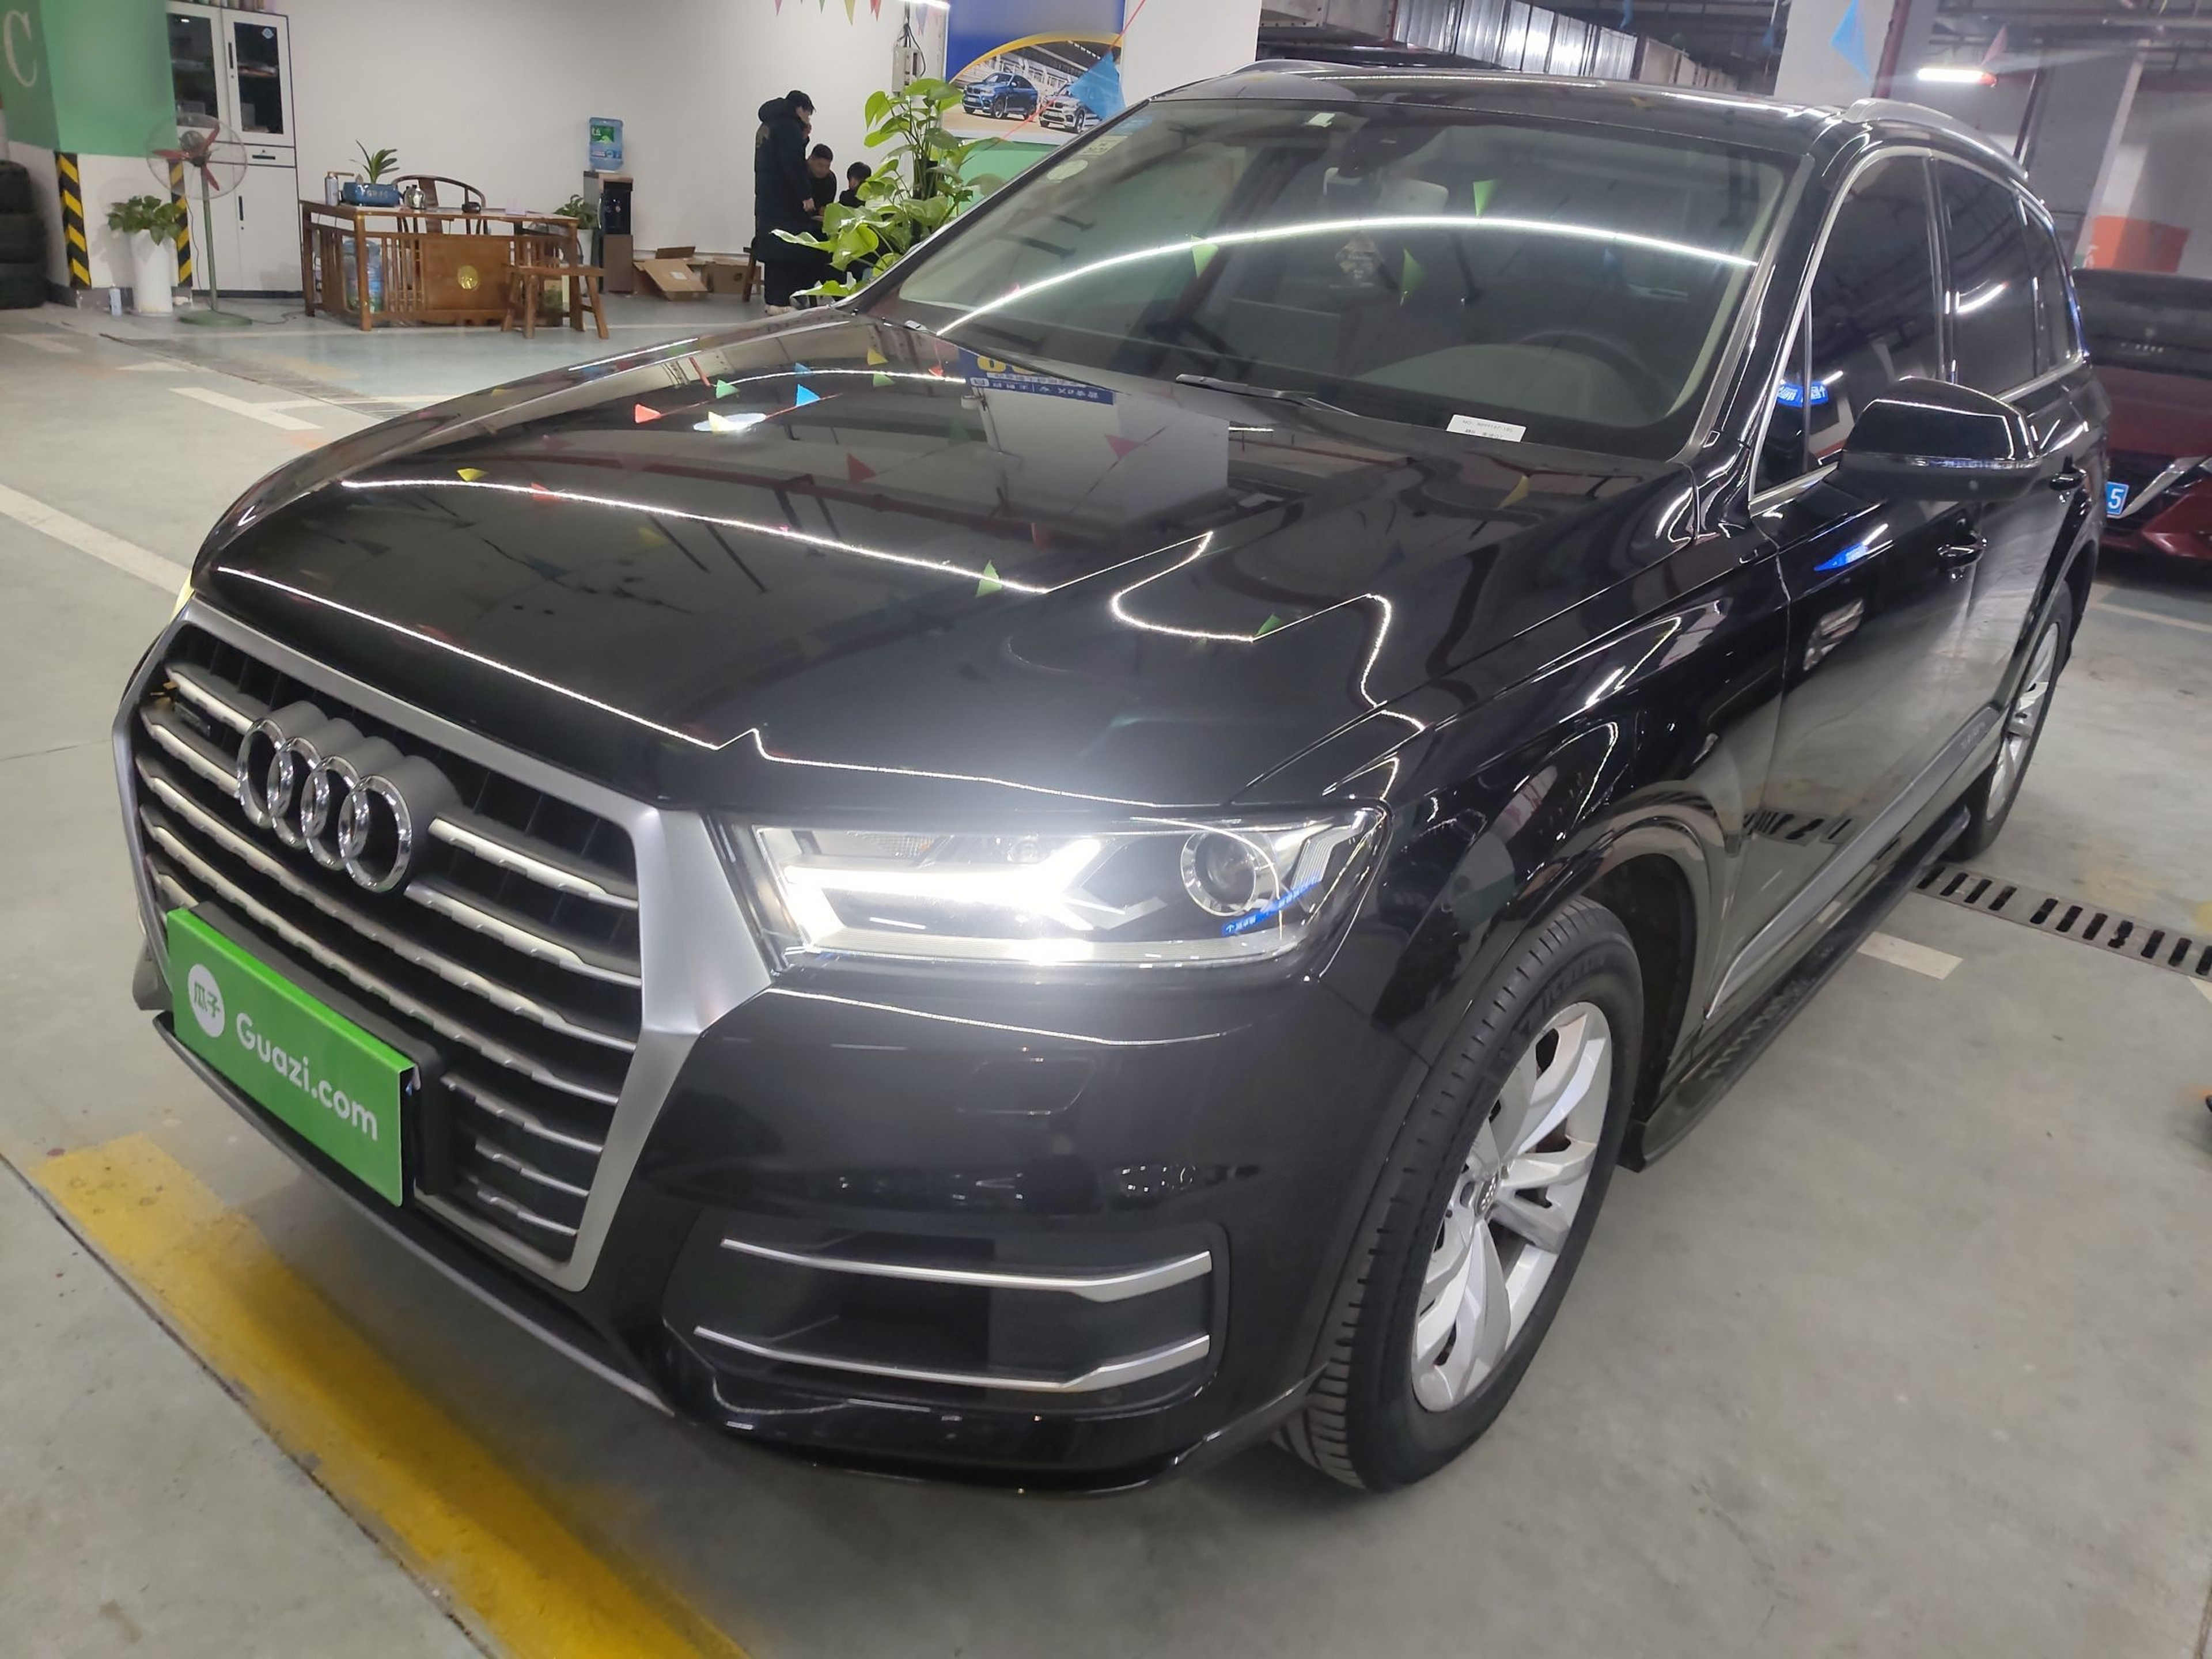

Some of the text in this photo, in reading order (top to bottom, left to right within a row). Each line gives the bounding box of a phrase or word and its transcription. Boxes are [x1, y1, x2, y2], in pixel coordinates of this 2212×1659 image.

[3, 10, 37, 86] C
[2108, 488, 2124, 509] 5
[194, 982, 220, 1018] 瓜子
[236, 1012, 377, 1141] Guazi.com
